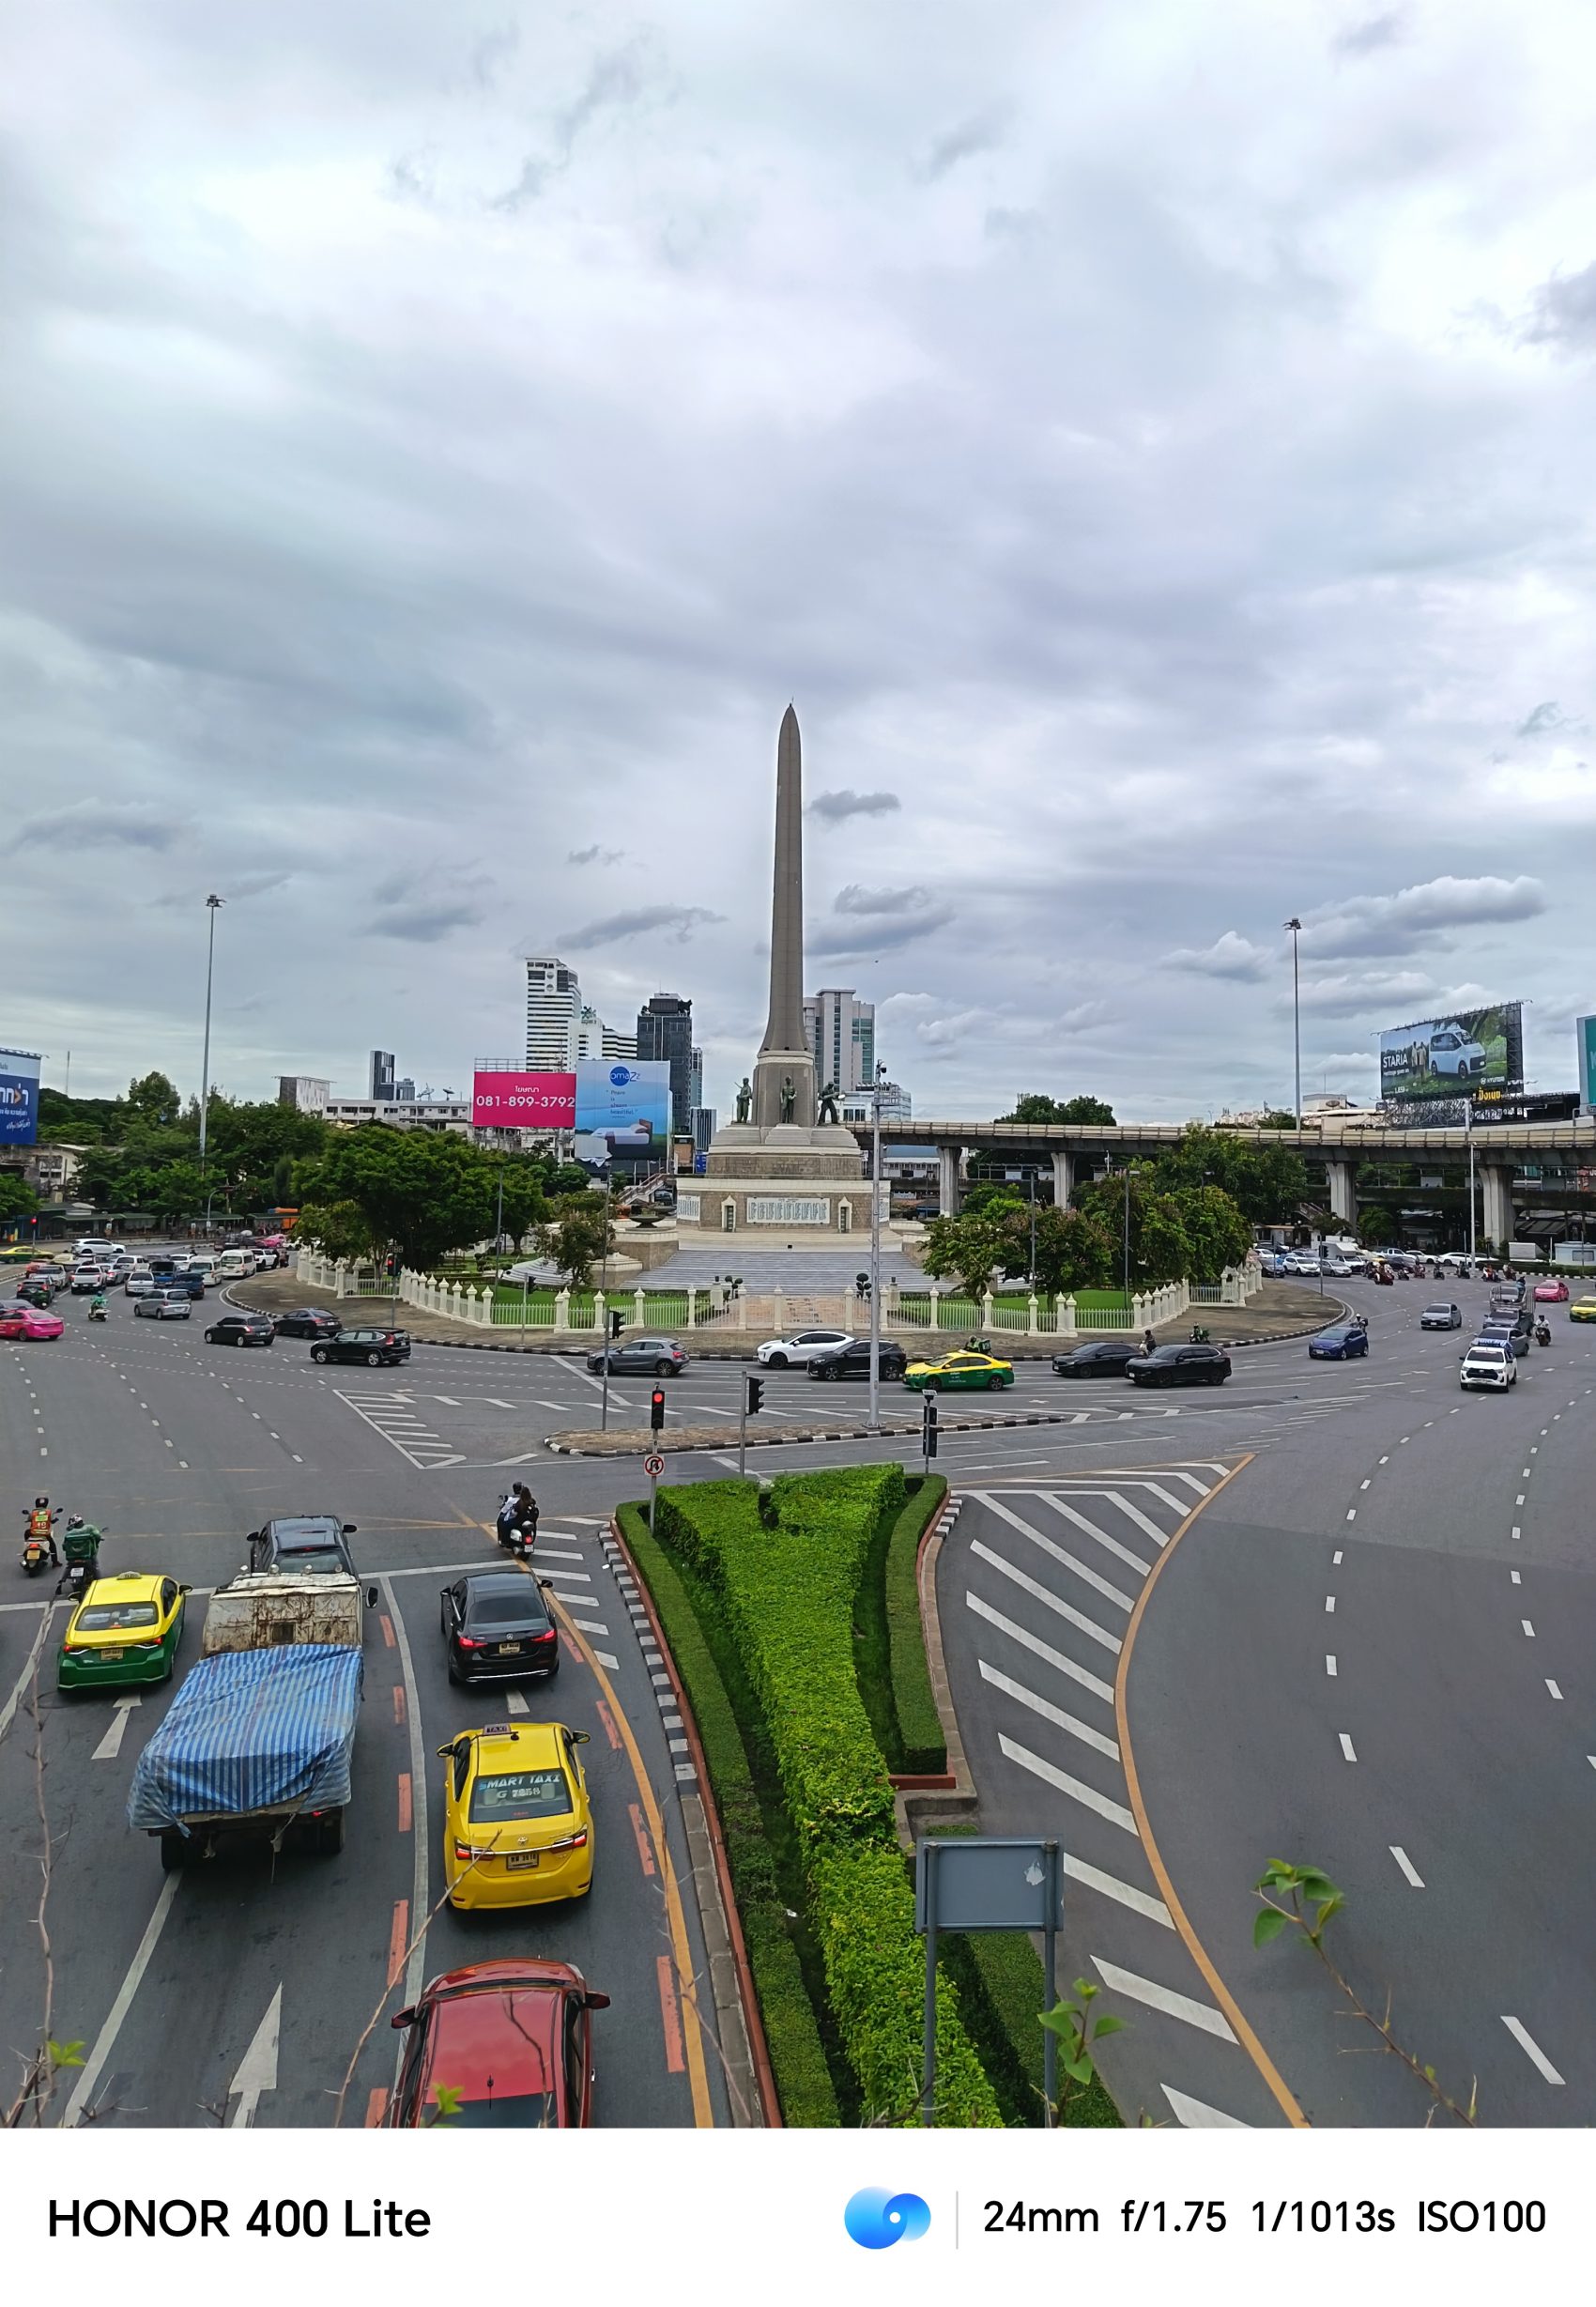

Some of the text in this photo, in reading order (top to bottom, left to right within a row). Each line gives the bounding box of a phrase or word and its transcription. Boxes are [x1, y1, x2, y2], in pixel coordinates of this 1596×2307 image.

[1383, 1054, 1408, 1069] STARIA
[476, 1095, 575, 1108] 081-899-3792
[479, 1774, 561, 1791] SMART TAXI
[496, 1790, 508, 1799] G
